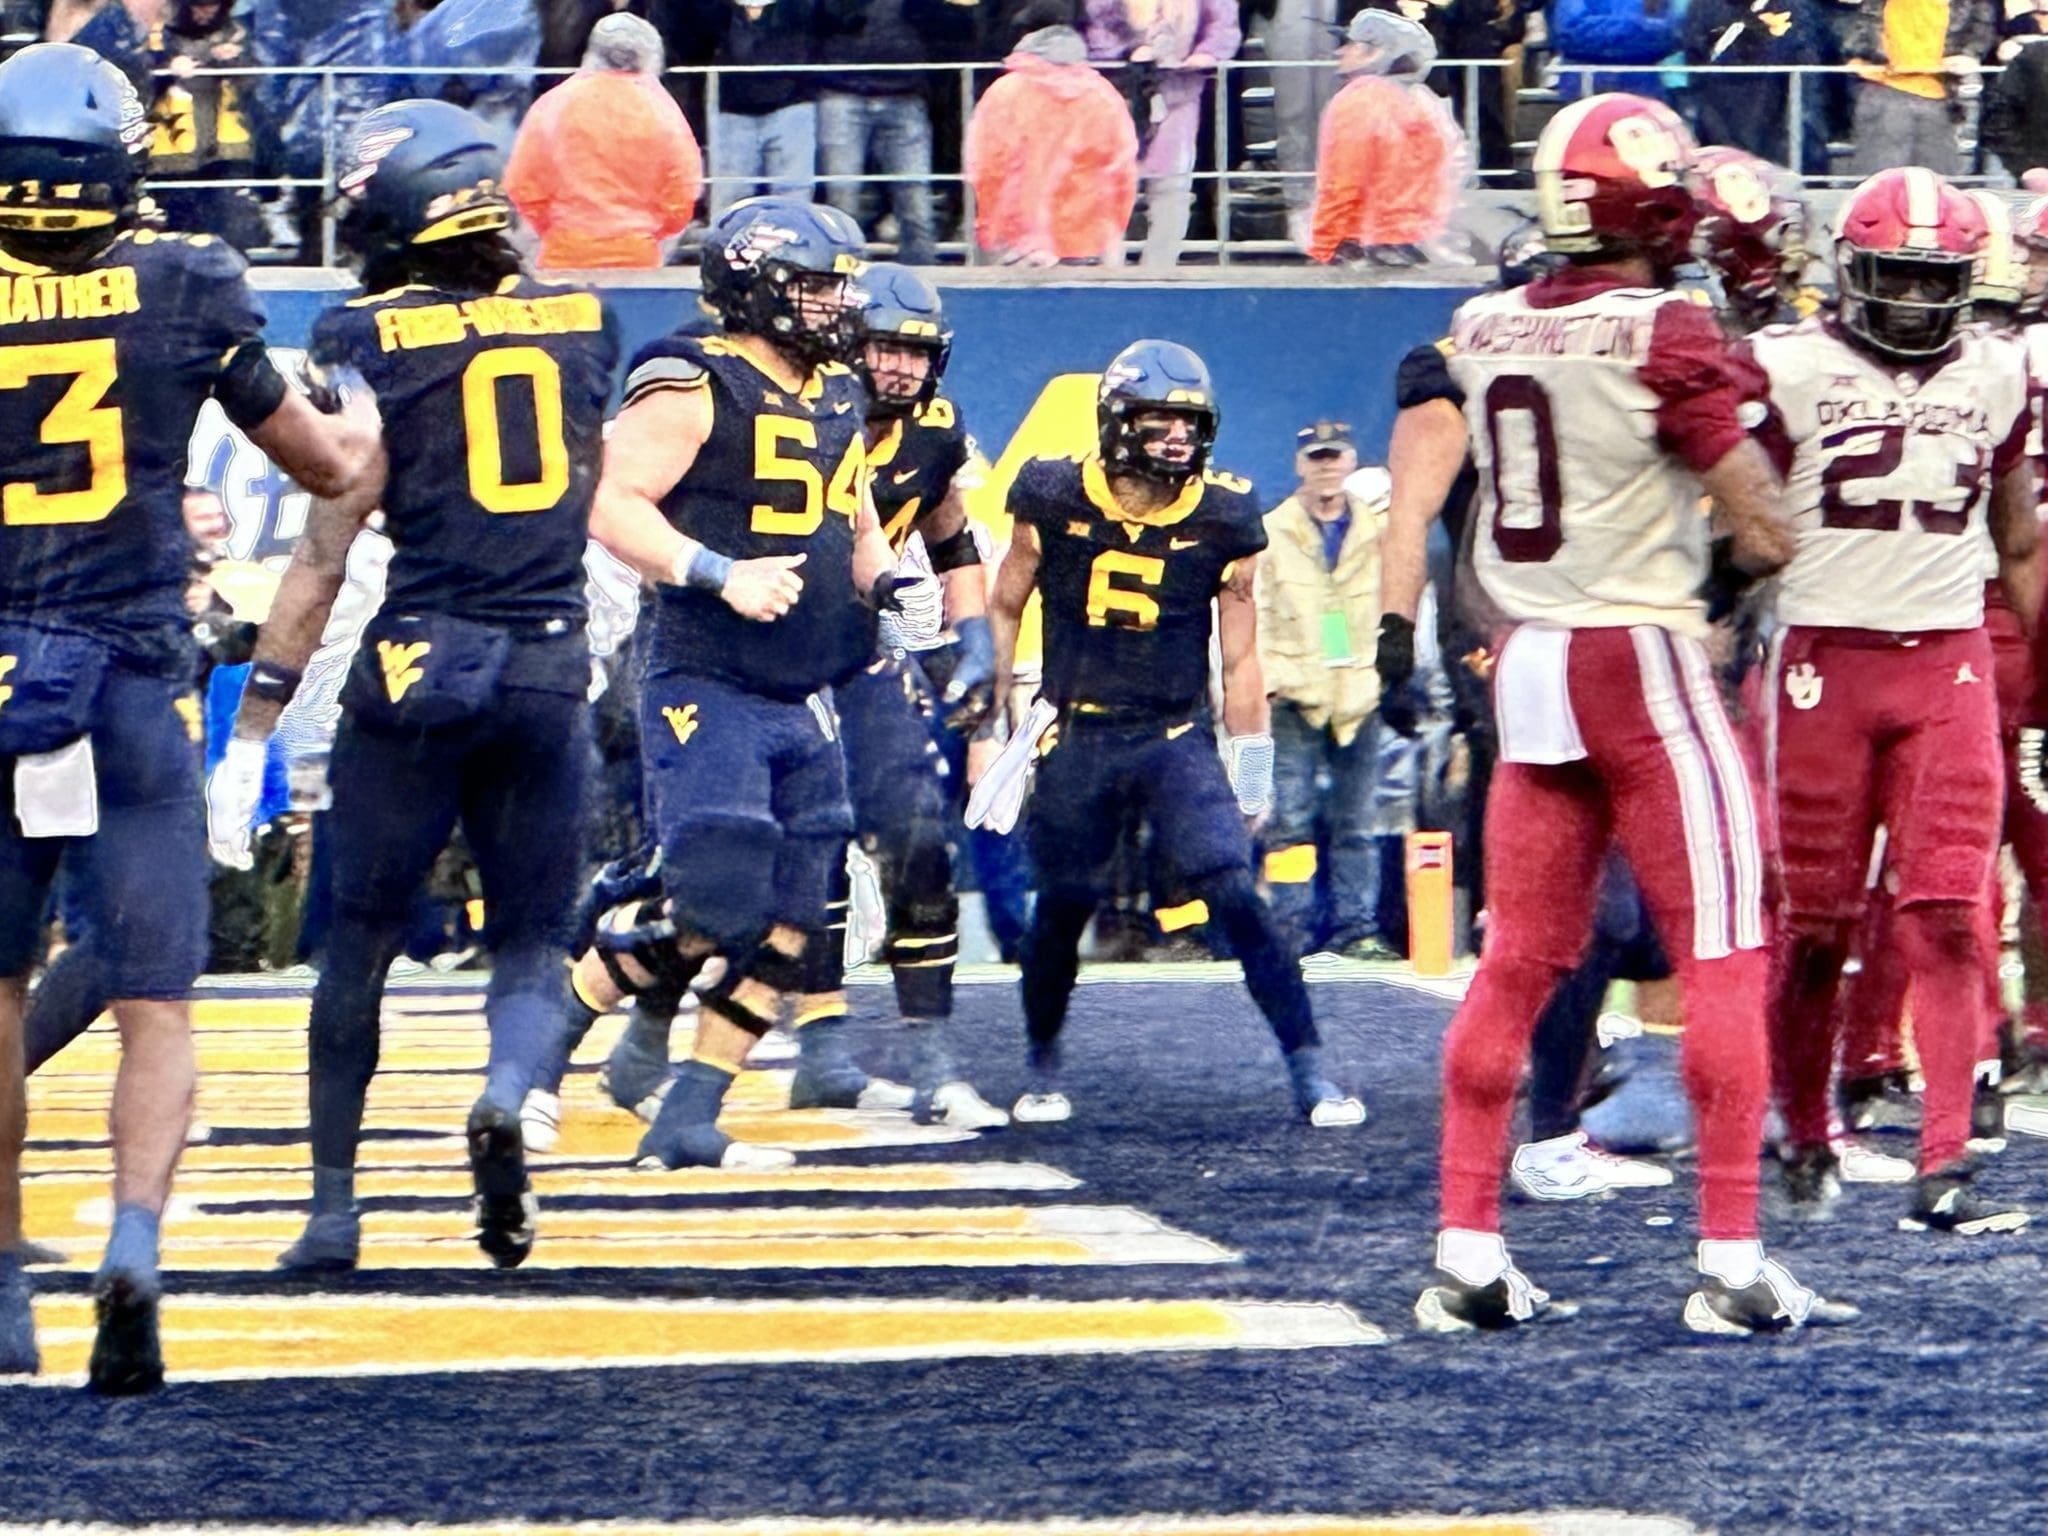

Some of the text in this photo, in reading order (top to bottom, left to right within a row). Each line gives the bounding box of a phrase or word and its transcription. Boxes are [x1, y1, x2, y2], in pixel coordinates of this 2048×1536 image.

[0, 265, 141, 326] ATHER
[0, 337, 127, 526] 3
[463, 346, 570, 514] 0
[751, 413, 866, 536] 54
[1486, 374, 1564, 563] 0
[1820, 425, 1986, 536] 23
[1086, 549, 1165, 632] 6
